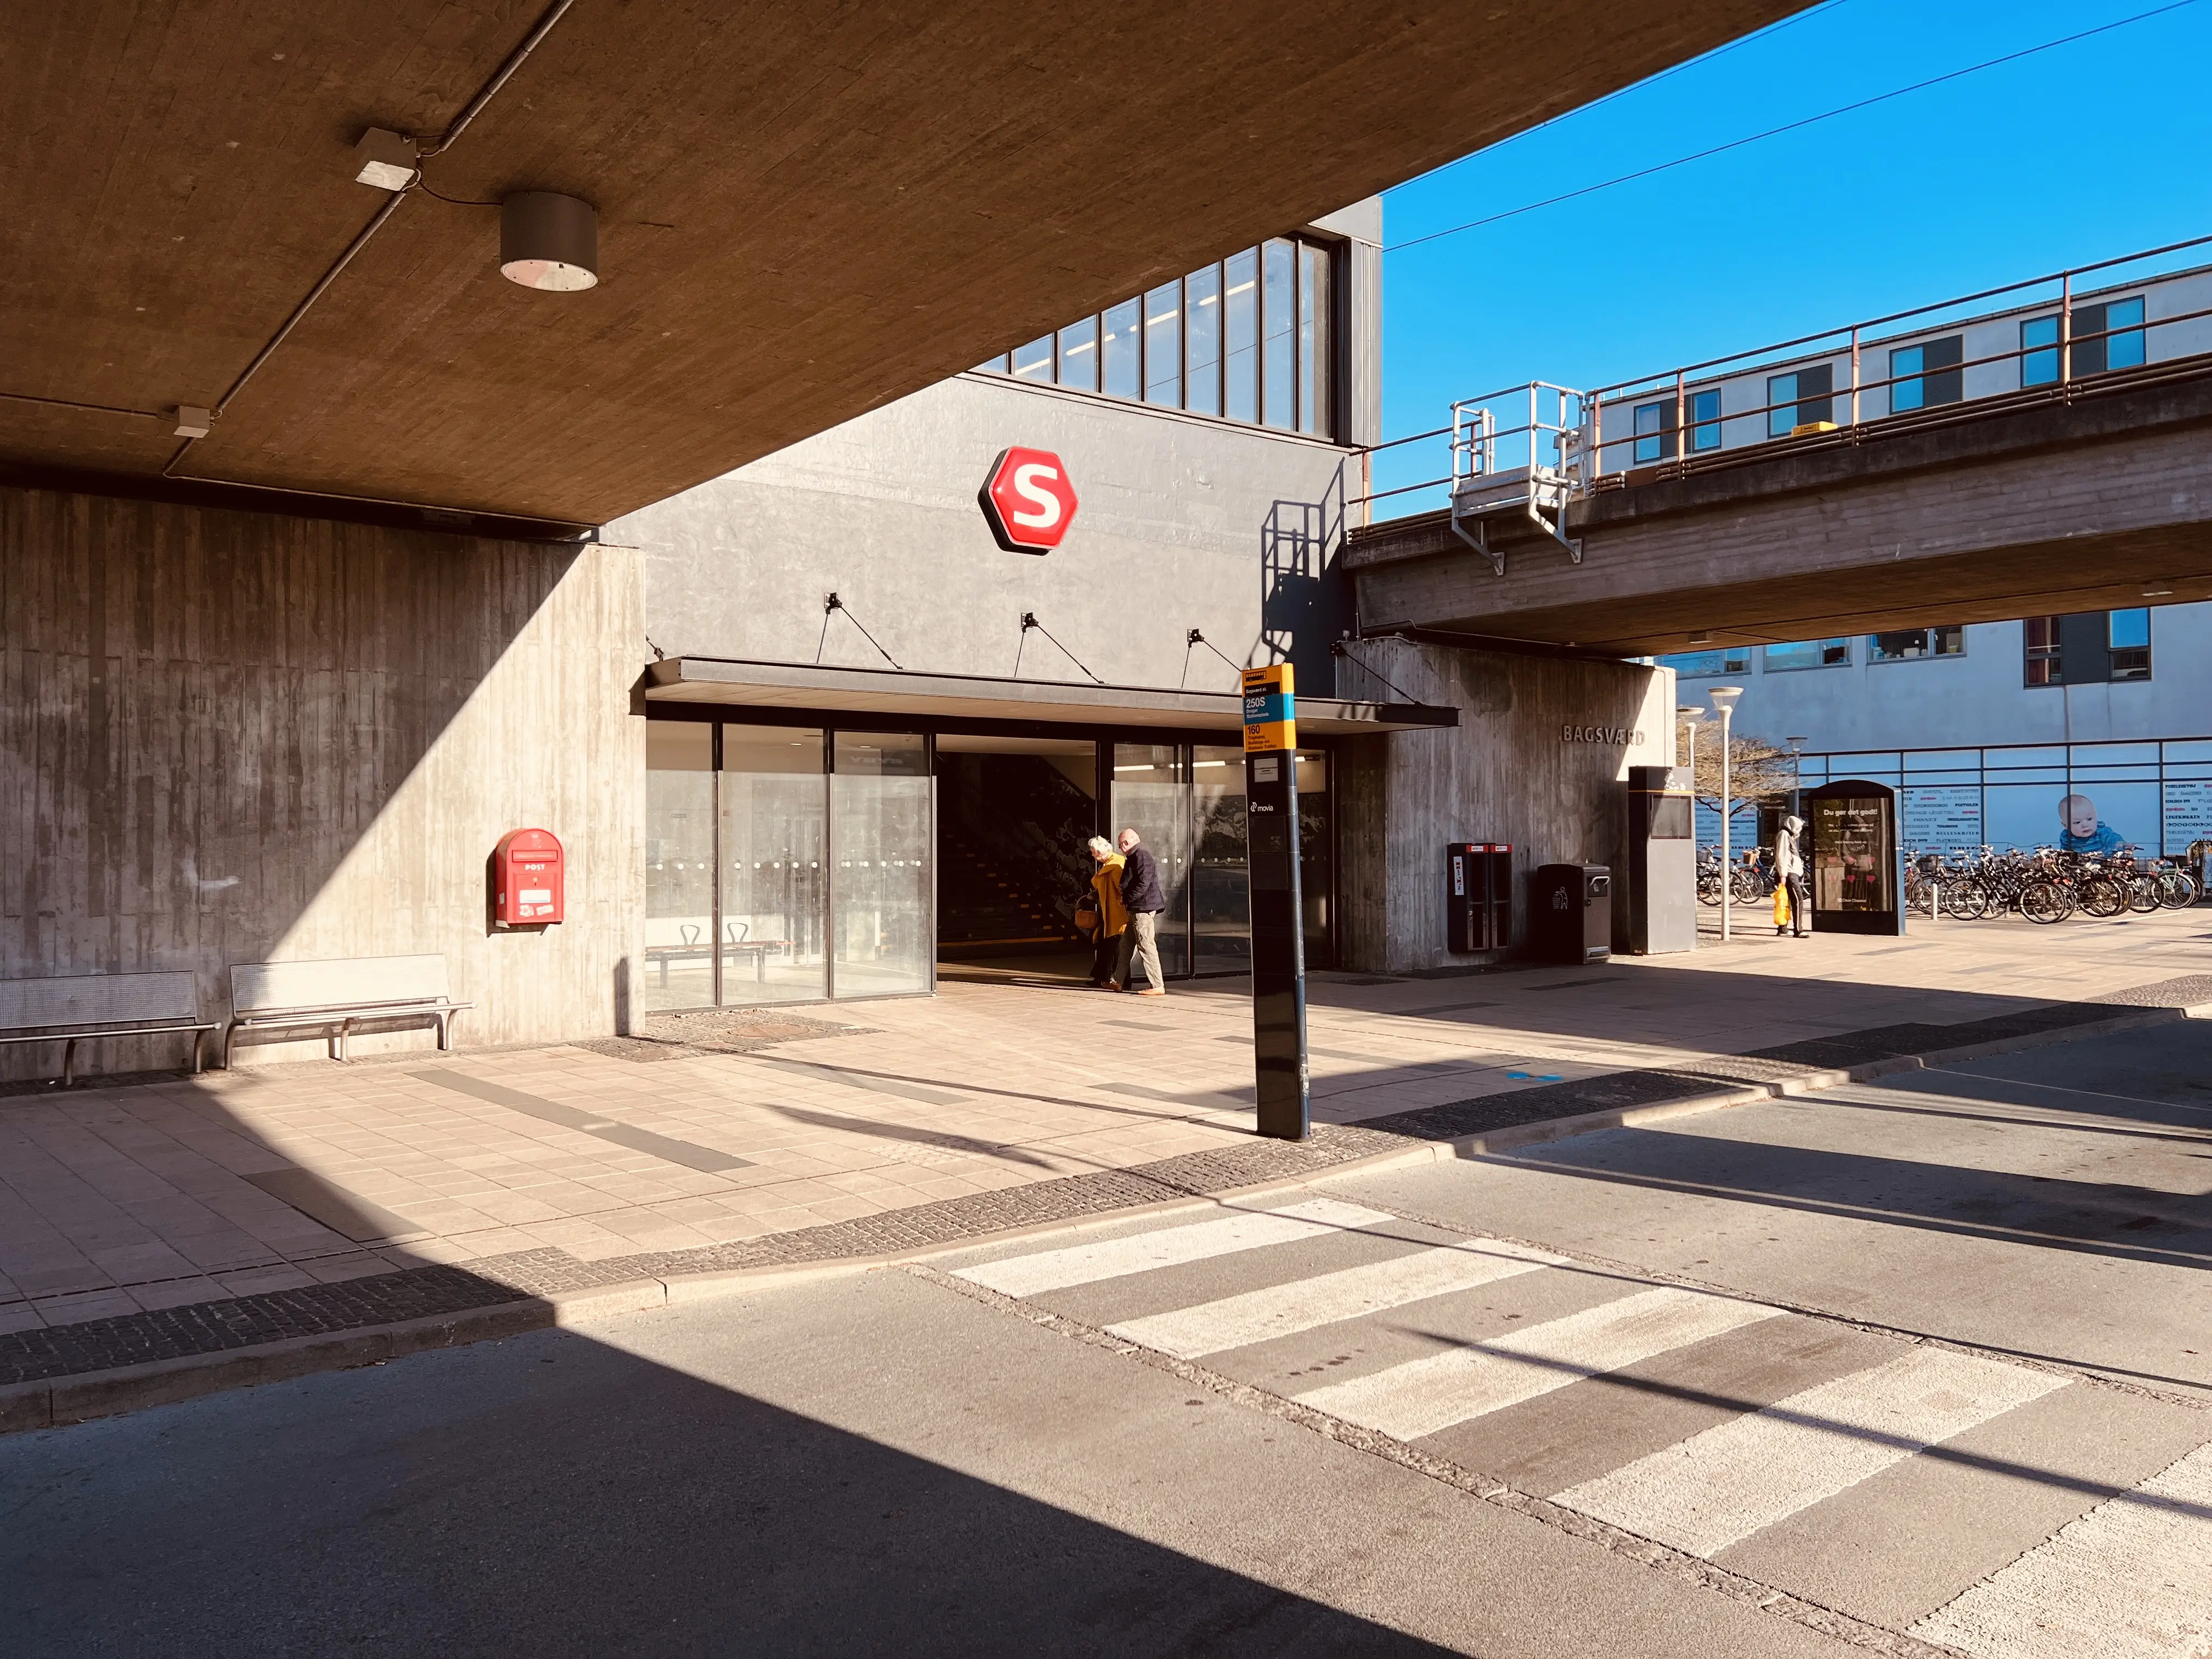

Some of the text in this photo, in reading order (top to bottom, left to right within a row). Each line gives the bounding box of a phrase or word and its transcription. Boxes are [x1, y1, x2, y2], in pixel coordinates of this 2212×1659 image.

[1013, 464, 1060, 528] S
[1246, 697, 1266, 708] 250S
[1248, 725, 1260, 735] 160
[1563, 724, 1645, 746] BAGSVÆRD
